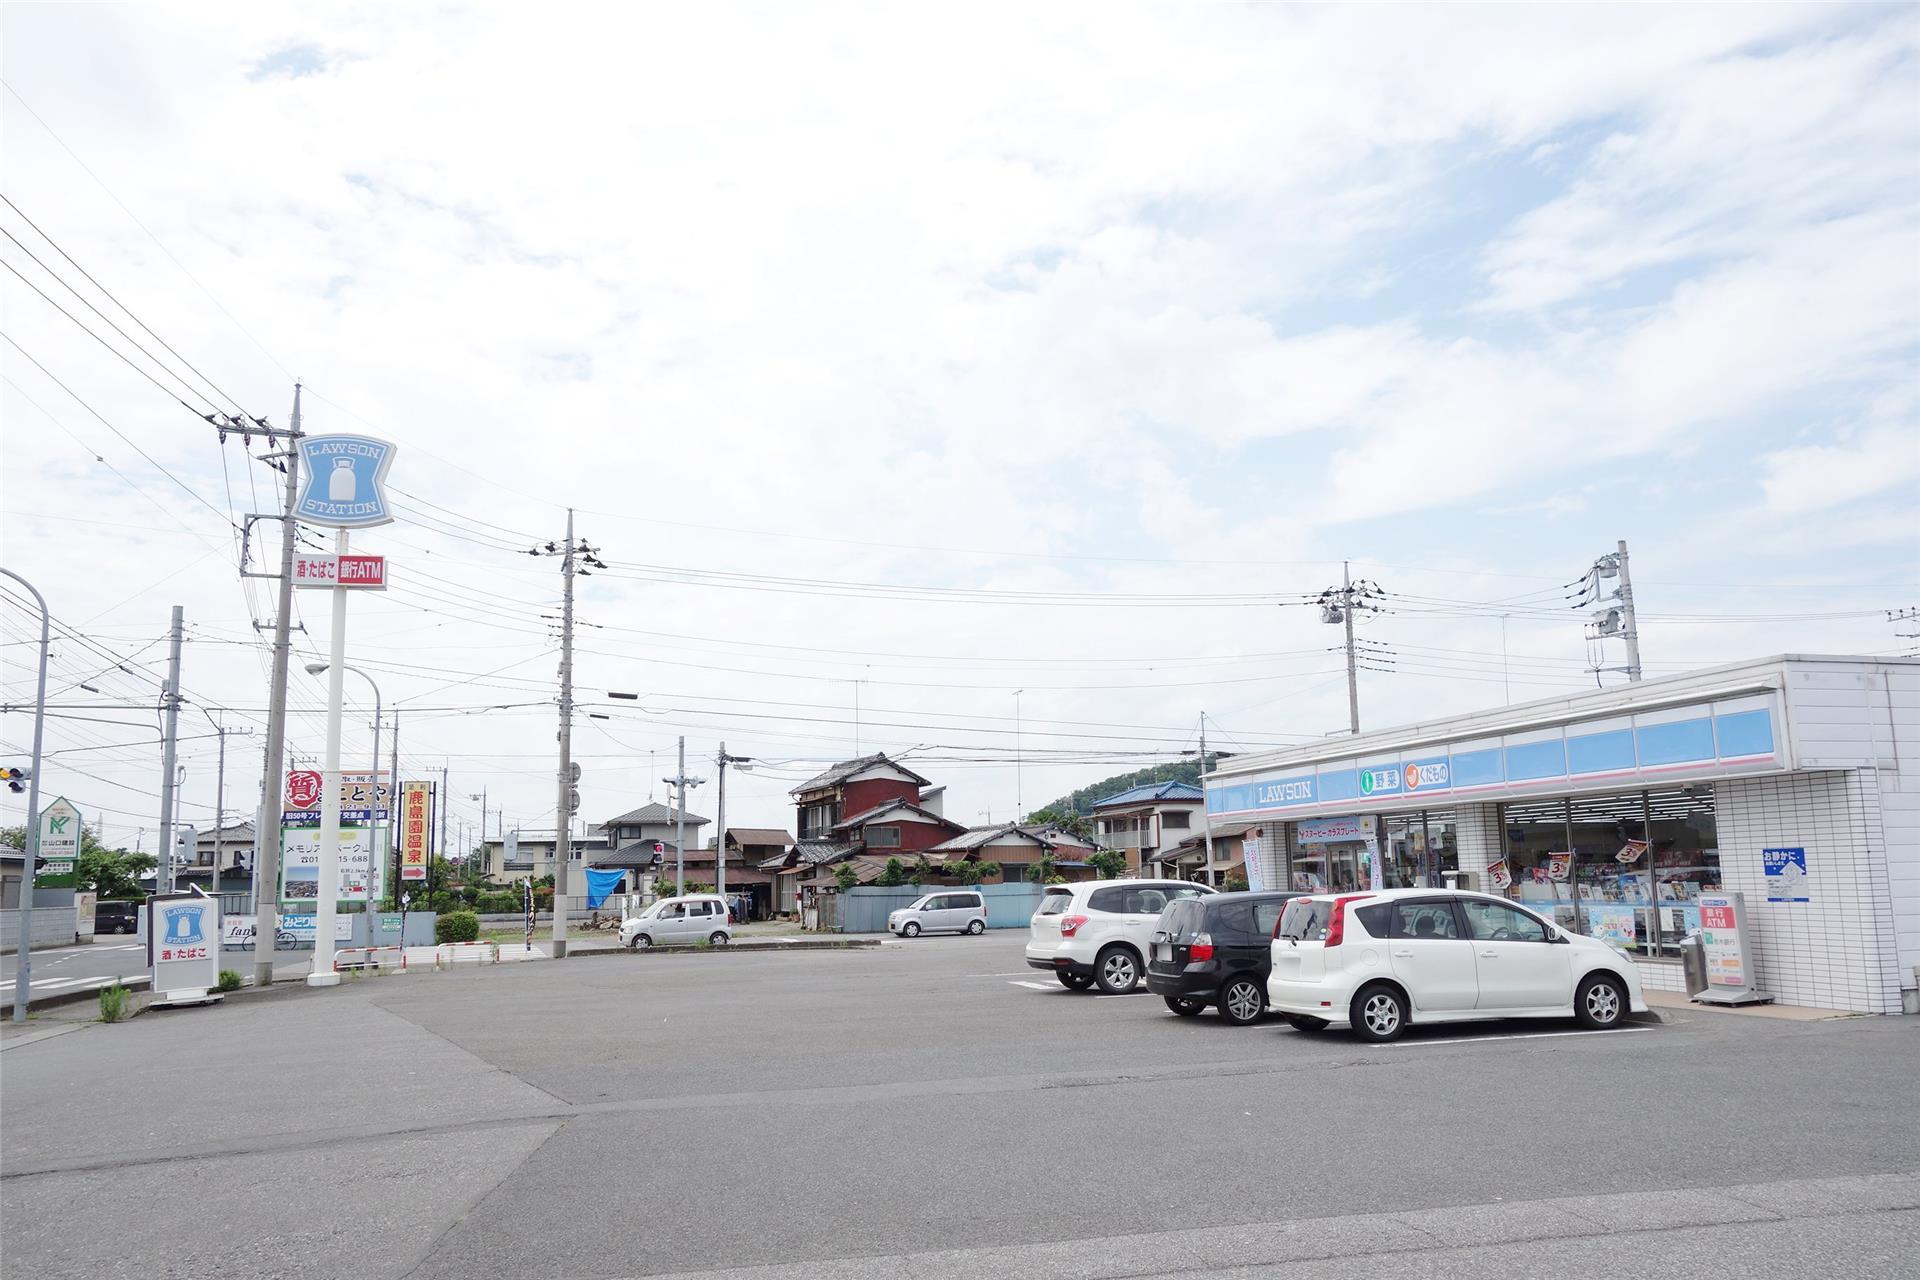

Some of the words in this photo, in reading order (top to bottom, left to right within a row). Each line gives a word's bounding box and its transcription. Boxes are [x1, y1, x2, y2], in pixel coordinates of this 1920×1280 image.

[309, 443, 380, 458] LAWSON
[305, 499, 378, 514] STATION
[297, 560, 335, 578] 酒・たばこ
[340, 561, 381, 578] 銀行ATM
[1375, 772, 1398, 788] 野菜
[1419, 765, 1447, 783] くだもの
[1258, 780, 1312, 803] LAWSON
[407, 791, 424, 863] 鹿島園温泉
[166, 907, 202, 917] LAWSON
[1706, 918, 1726, 928] ATM
[166, 934, 201, 943] STATION
[162, 948, 206, 960] 酒・たばこ
